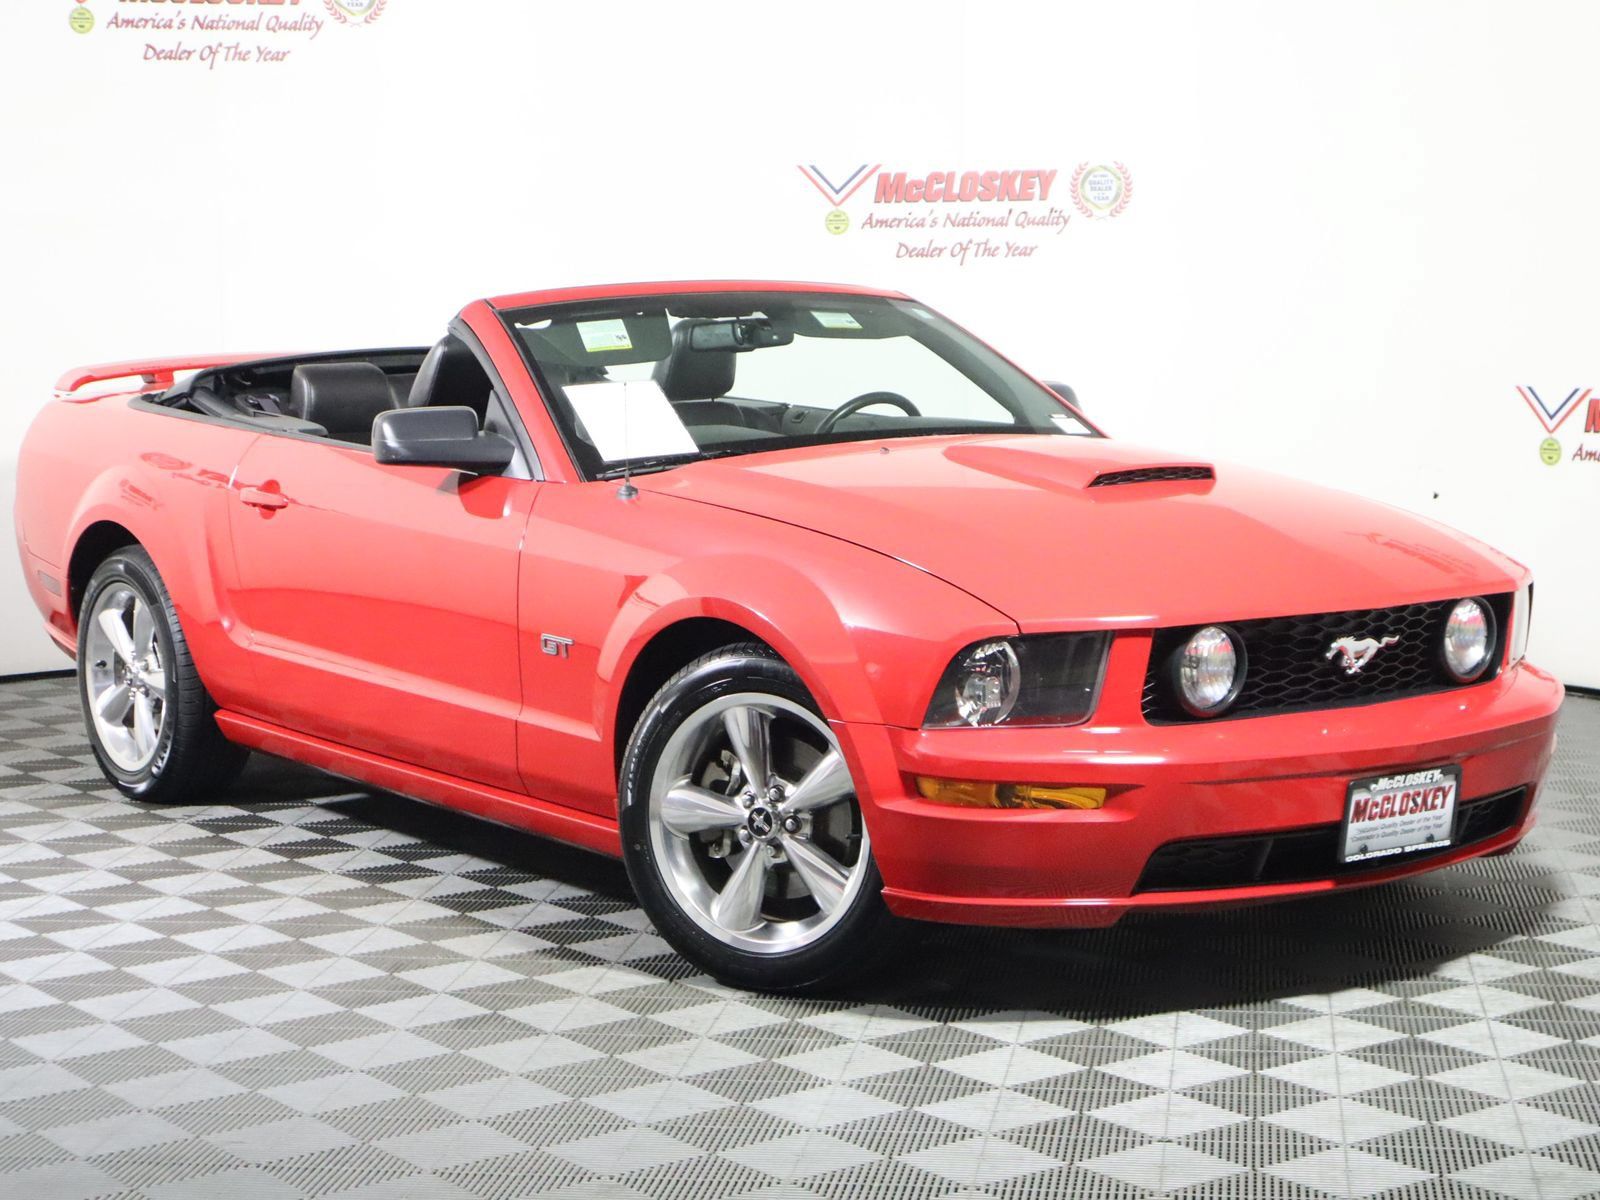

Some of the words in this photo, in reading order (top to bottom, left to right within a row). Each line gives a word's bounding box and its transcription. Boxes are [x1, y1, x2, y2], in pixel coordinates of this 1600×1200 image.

[106, 10, 187, 29] America's
[191, 11, 263, 30] National
[266, 11, 324, 40] Quality
[143, 41, 196, 61] Dealer
[199, 42, 222, 70] Of
[224, 42, 251, 62] The
[255, 45, 291, 62] Year
[874, 169, 1057, 203] McCLOSKEY
[861, 209, 939, 229] America's
[943, 208, 1012, 228] National
[1015, 207, 1070, 235] Quality
[896, 239, 947, 258] Dealer
[950, 238, 973, 266] Of
[974, 238, 1000, 258] The
[1004, 241, 1038, 258] Year
[541, 633, 573, 658] GT
[1378, 769, 1441, 790] McCLOSKEY
[1350, 784, 1453, 823] McCLOSKEY
[1345, 847, 1402, 863] COLORADO
[1404, 839, 1451, 853] SPRINGS
